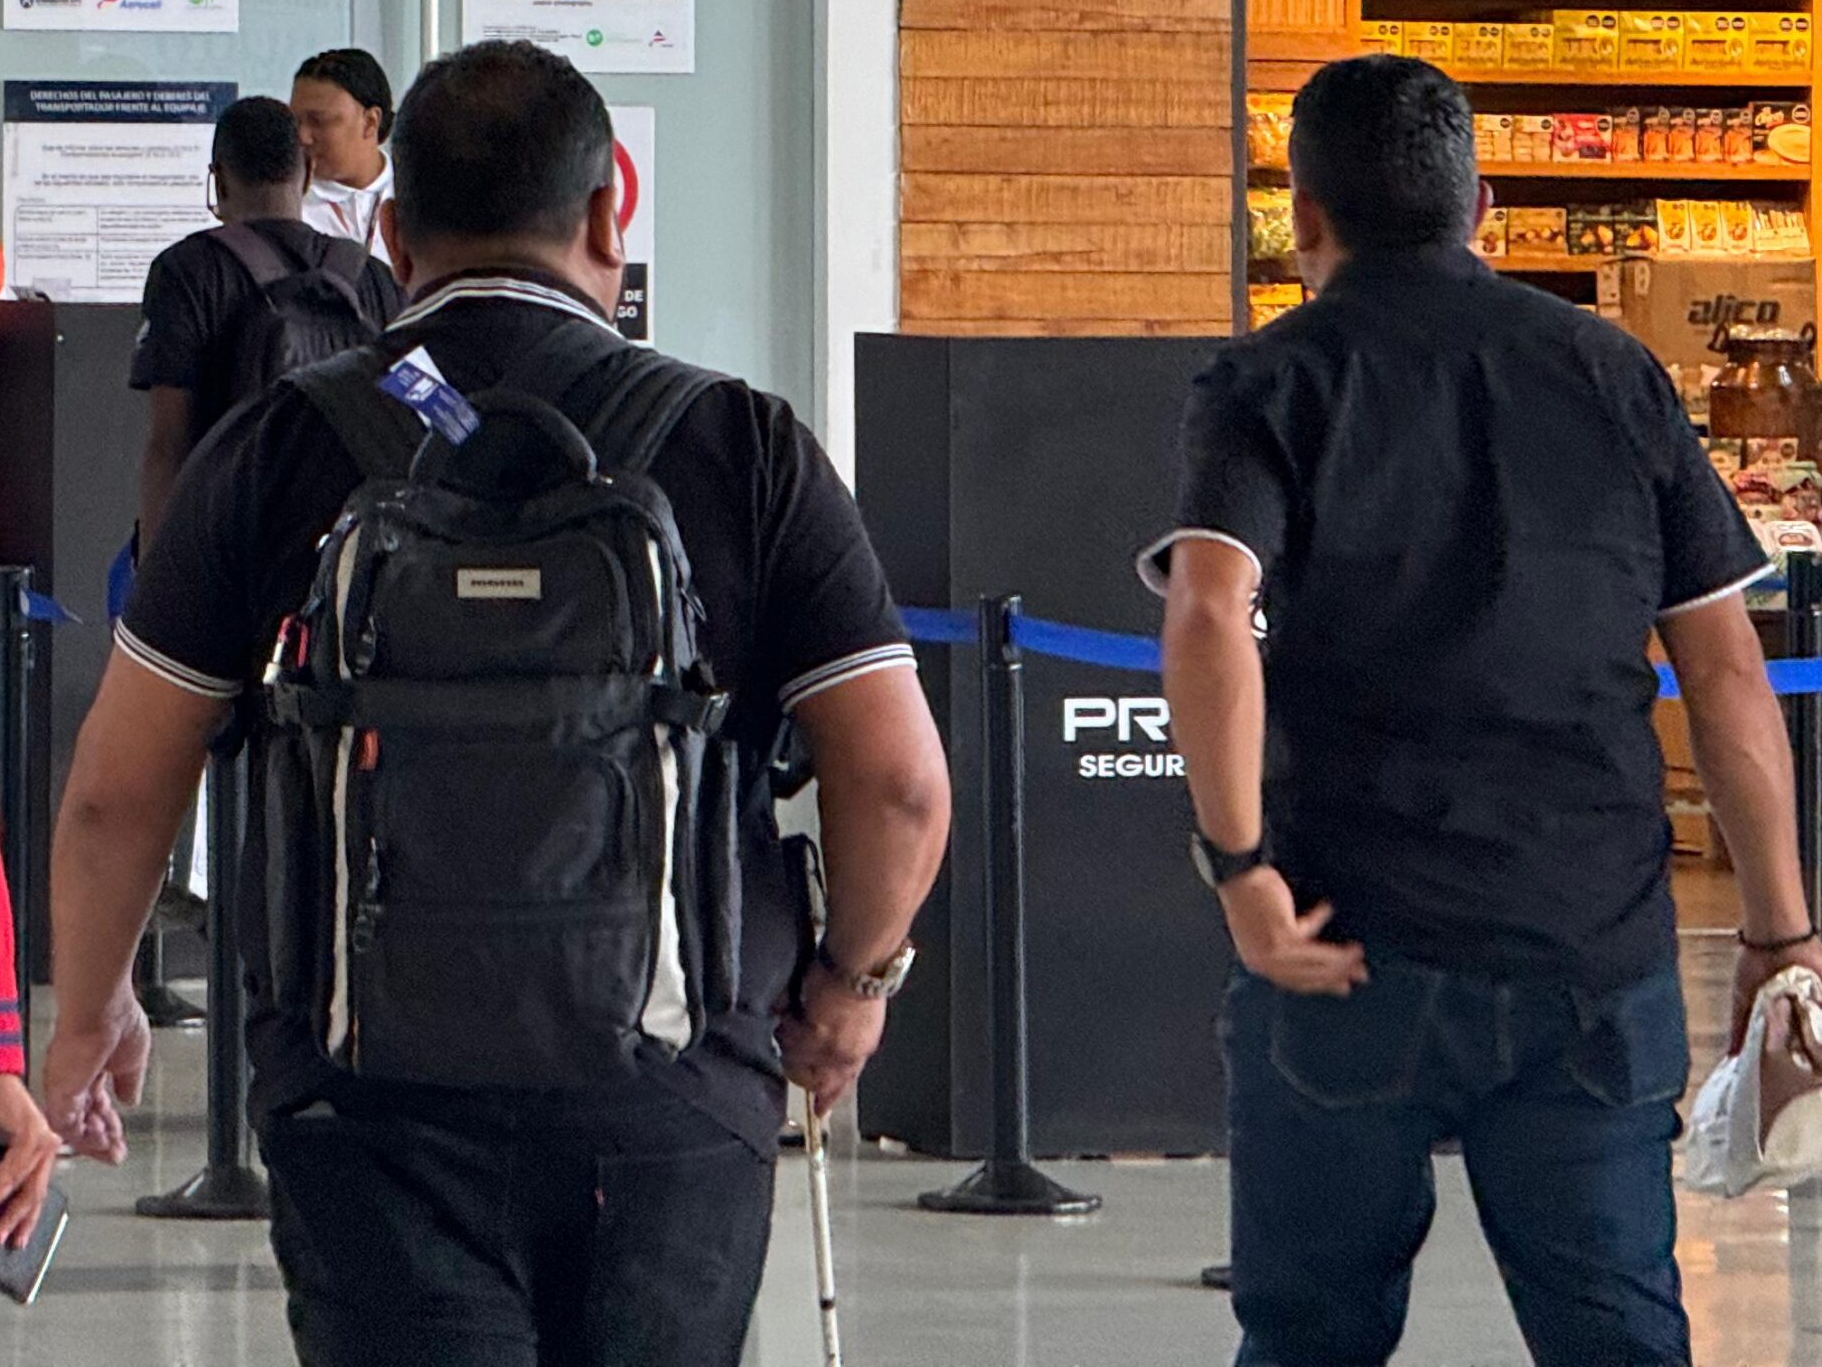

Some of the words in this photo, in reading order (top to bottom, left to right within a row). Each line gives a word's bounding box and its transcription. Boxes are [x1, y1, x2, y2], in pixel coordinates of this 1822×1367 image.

[30, 90, 79, 101] DERECHOS
[99, 90, 145, 101] PASAJERO
[36, 102, 114, 113] TRANSPORTADOR
[624, 289, 644, 303] DE
[1063, 697, 1171, 742] PR
[1078, 754, 1186, 778] SEGUR
